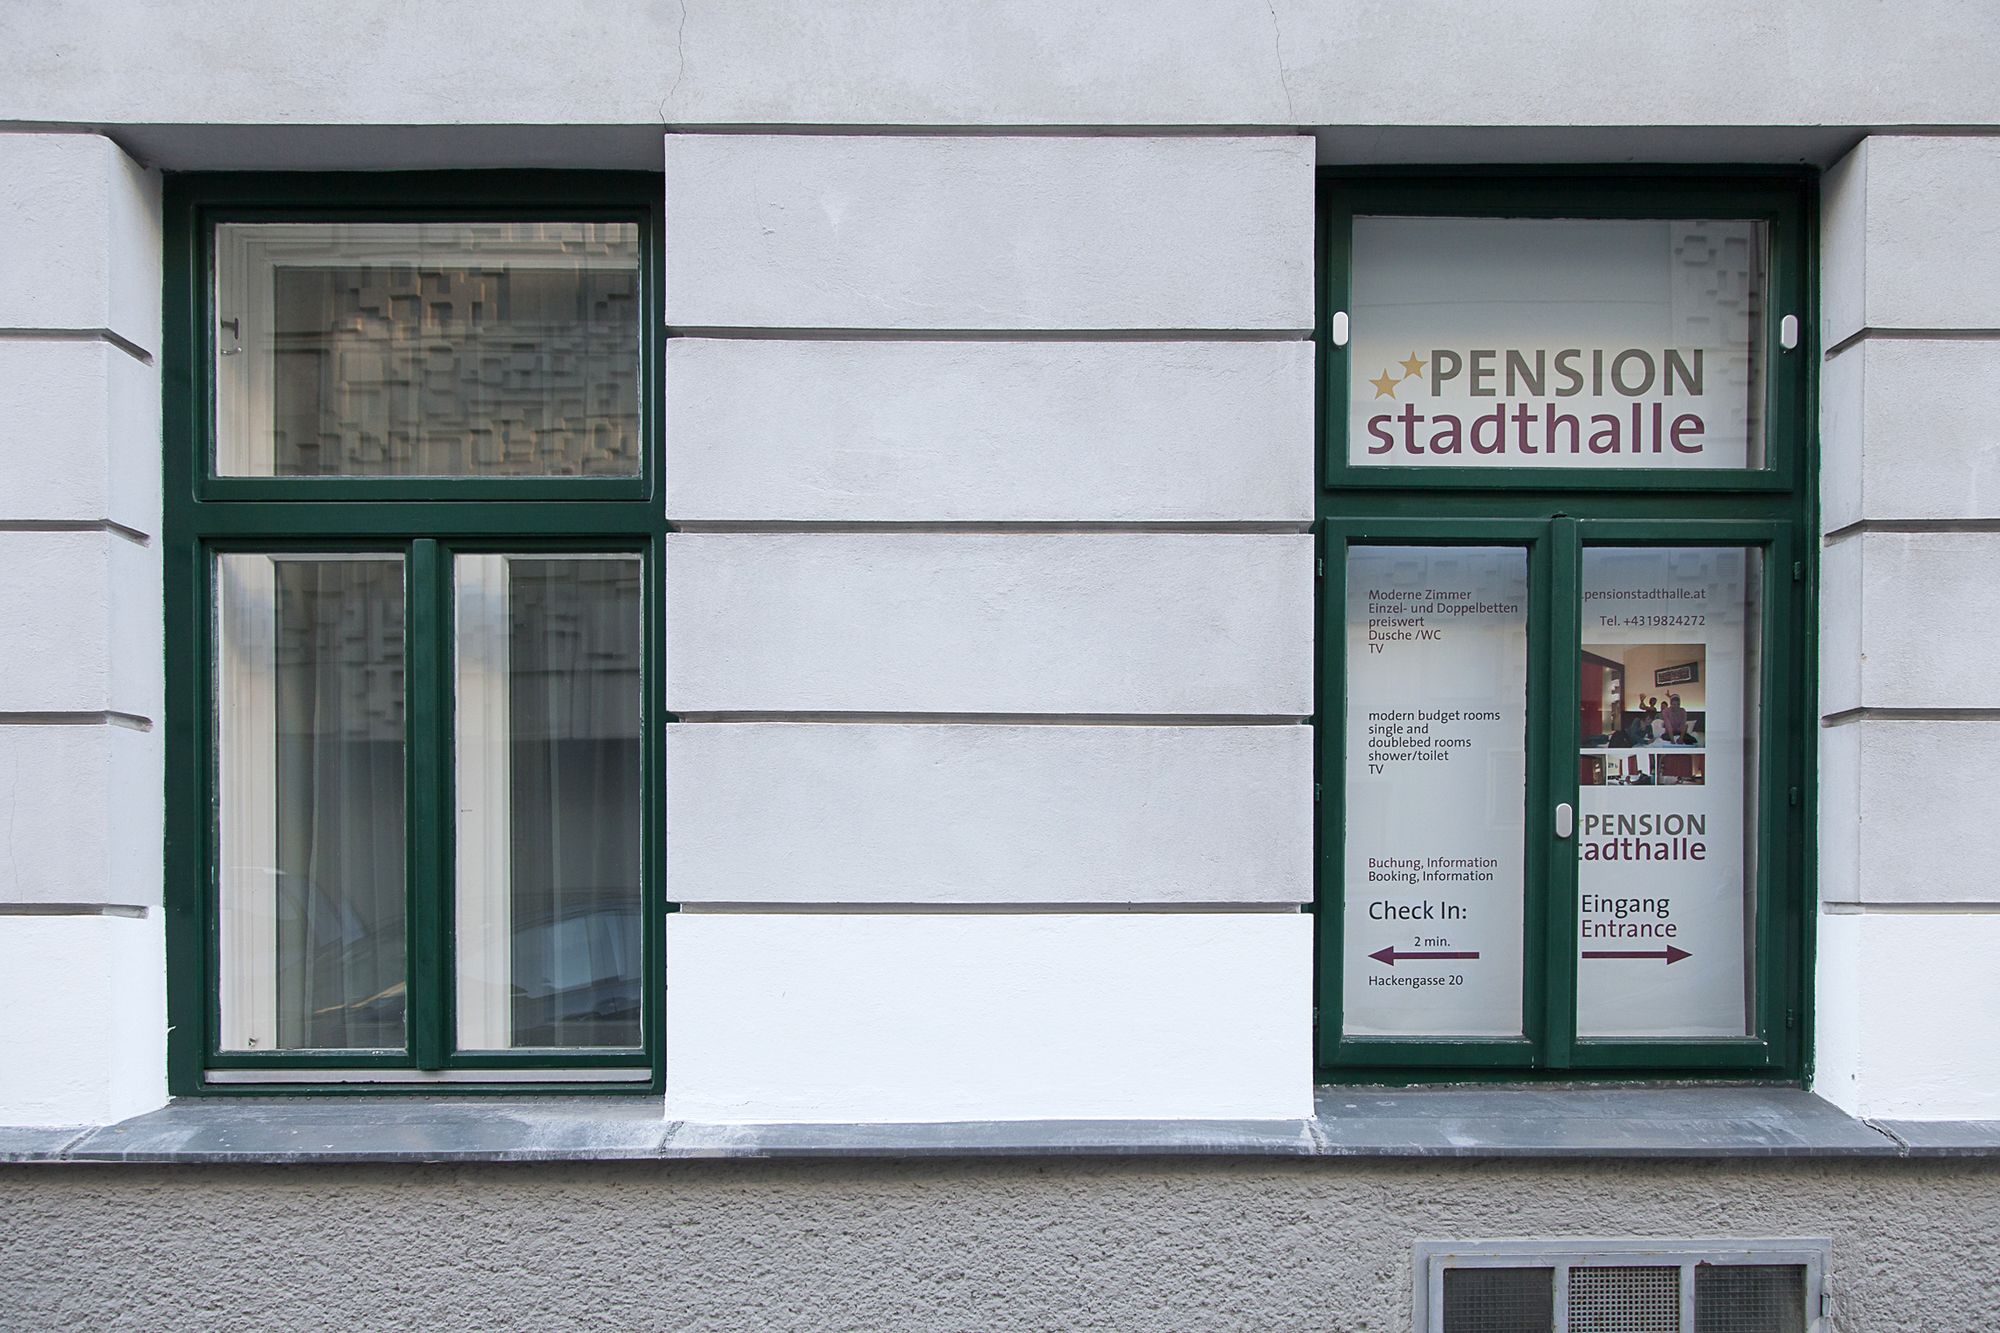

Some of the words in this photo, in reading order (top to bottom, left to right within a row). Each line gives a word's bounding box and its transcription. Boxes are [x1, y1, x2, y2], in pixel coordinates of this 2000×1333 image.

[1431, 349, 1704, 397] PENSION
[1367, 402, 1705, 455] stadthalle
[1368, 589, 1422, 600] Moderne
[1425, 589, 1472, 600] Zimmer
[1368, 602, 1407, 614] Einzel-
[1411, 602, 1434, 614] und
[1437, 602, 1518, 616] Doppelbetten
[1368, 616, 1425, 629] preiswert
[1600, 615, 1620, 627] Tel.
[1623, 615, 1706, 627] +4319824272
[1368, 629, 1412, 640] Dusche
[1368, 643, 1384, 654] TV
[1368, 709, 1415, 721] modern
[1418, 709, 1460, 723] budget
[1463, 711, 1501, 721] rooms
[1368, 723, 1404, 737] single
[1406, 723, 1429, 734] and
[1368, 736, 1431, 748] doublebed
[1434, 738, 1472, 748] rooms
[1368, 750, 1449, 761] shower/toilet
[1368, 764, 1384, 775] TV
[1585, 814, 1706, 836] PENSION
[1368, 857, 1424, 871] Buchung,
[1427, 857, 1498, 868] Information
[1368, 871, 1420, 884] Booking,
[1423, 871, 1494, 882] Information
[1368, 900, 1434, 920] Check
[1441, 901, 1467, 920] In:
[1582, 894, 1670, 919] Eingang
[1582, 919, 1677, 938] Entrance
[1414, 936, 1421, 947] 2
[1424, 936, 1451, 947] min.
[1368, 975, 1445, 989] Hackengasse
[1448, 975, 1464, 986] 20
